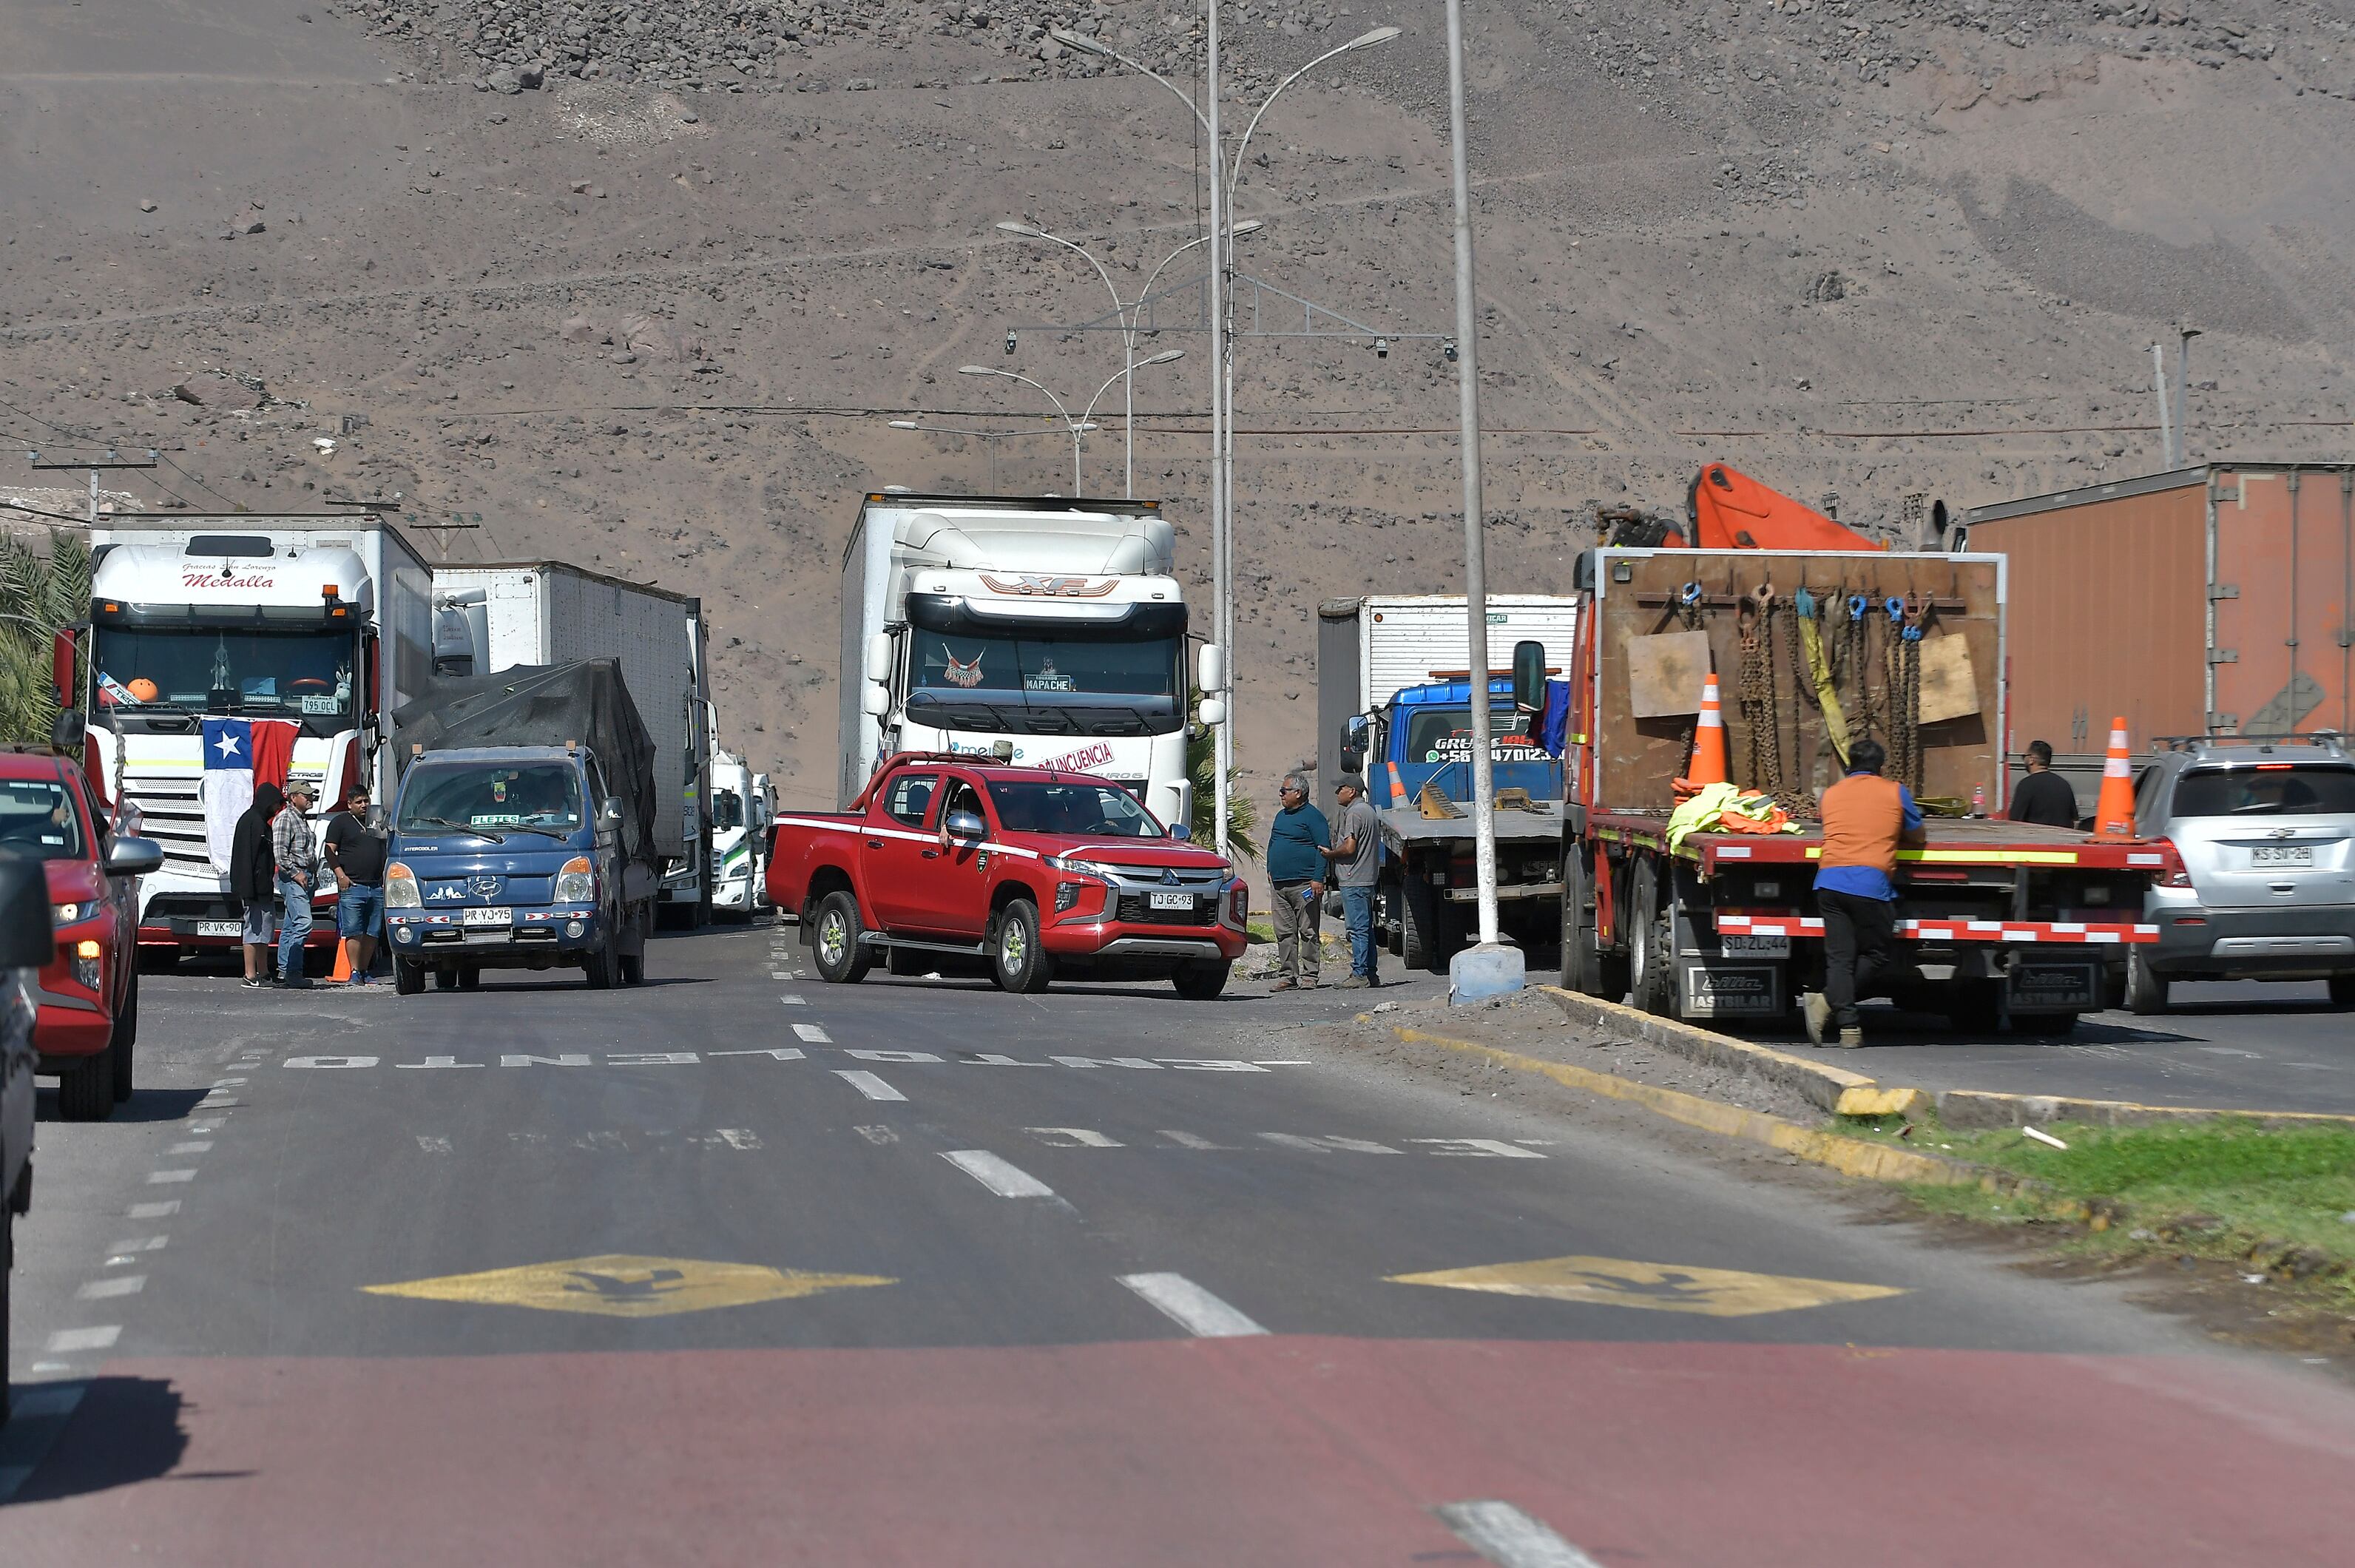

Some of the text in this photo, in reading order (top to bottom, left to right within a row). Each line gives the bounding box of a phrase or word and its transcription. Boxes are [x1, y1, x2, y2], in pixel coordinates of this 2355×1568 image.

[183, 563, 216, 572] Gracias
[182, 573, 273, 587] Medalla
[1012, 576, 1088, 590] XF
[1026, 680, 1069, 689] MAPACHE
[304, 700, 319, 710] 795
[473, 816, 518, 824] FLETES
